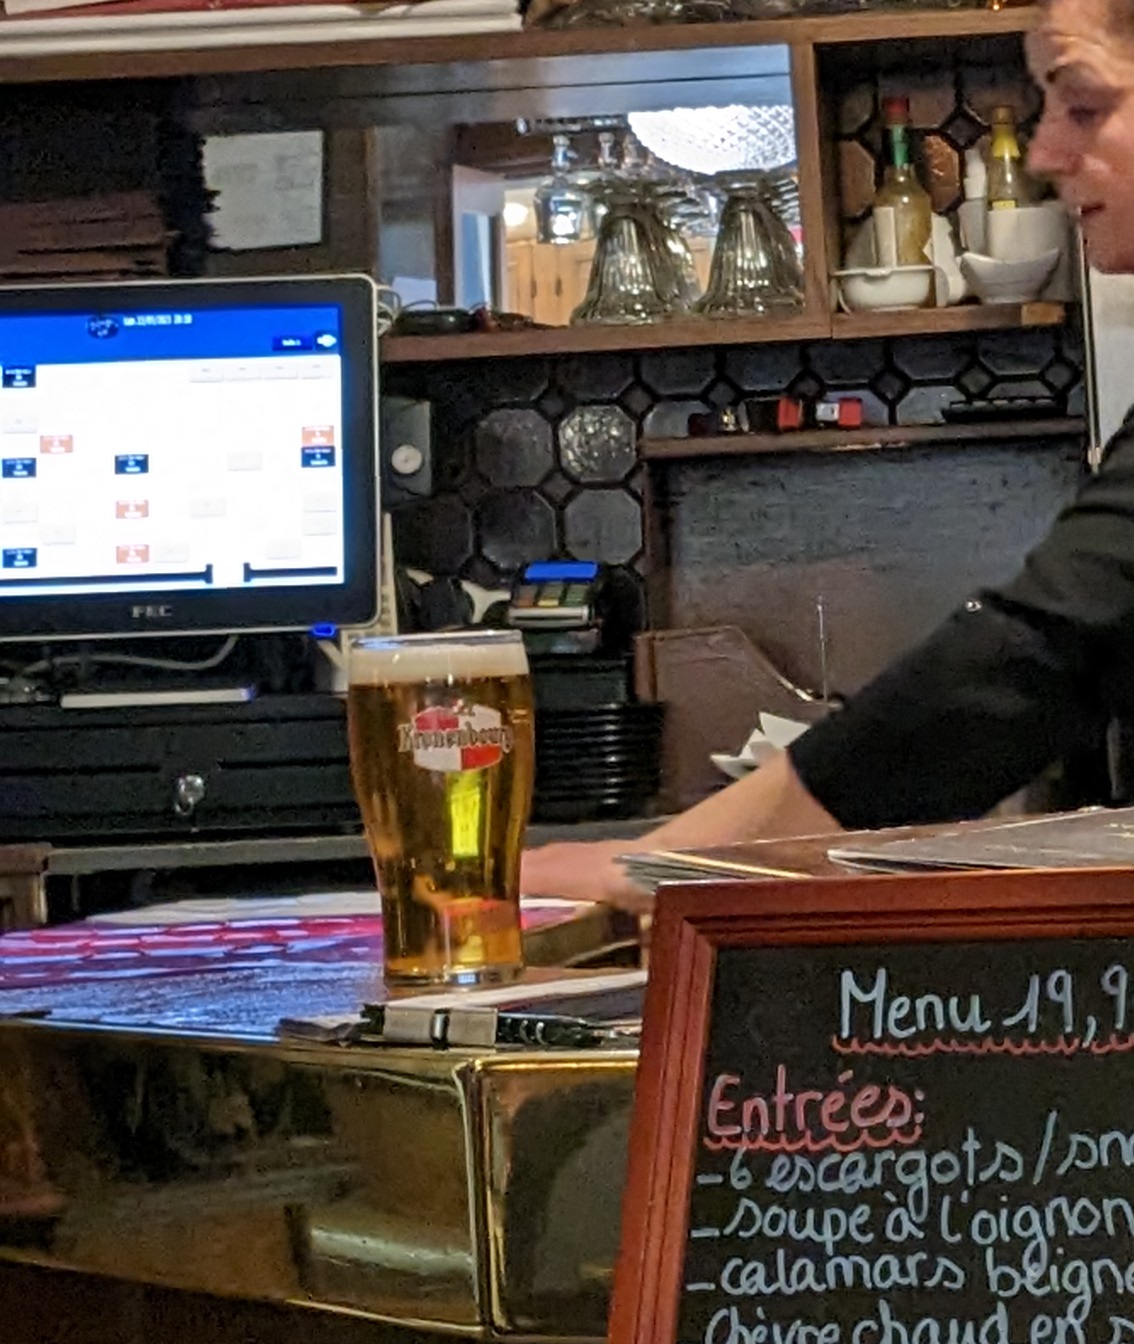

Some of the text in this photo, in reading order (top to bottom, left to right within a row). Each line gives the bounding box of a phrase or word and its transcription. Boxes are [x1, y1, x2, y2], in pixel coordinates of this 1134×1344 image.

[397, 720, 515, 754] Kronenbourg
[841, 967, 992, 1040] Menu
[707, 1064, 926, 1136] Entrées:
[885, 1190, 925, 1243] à
